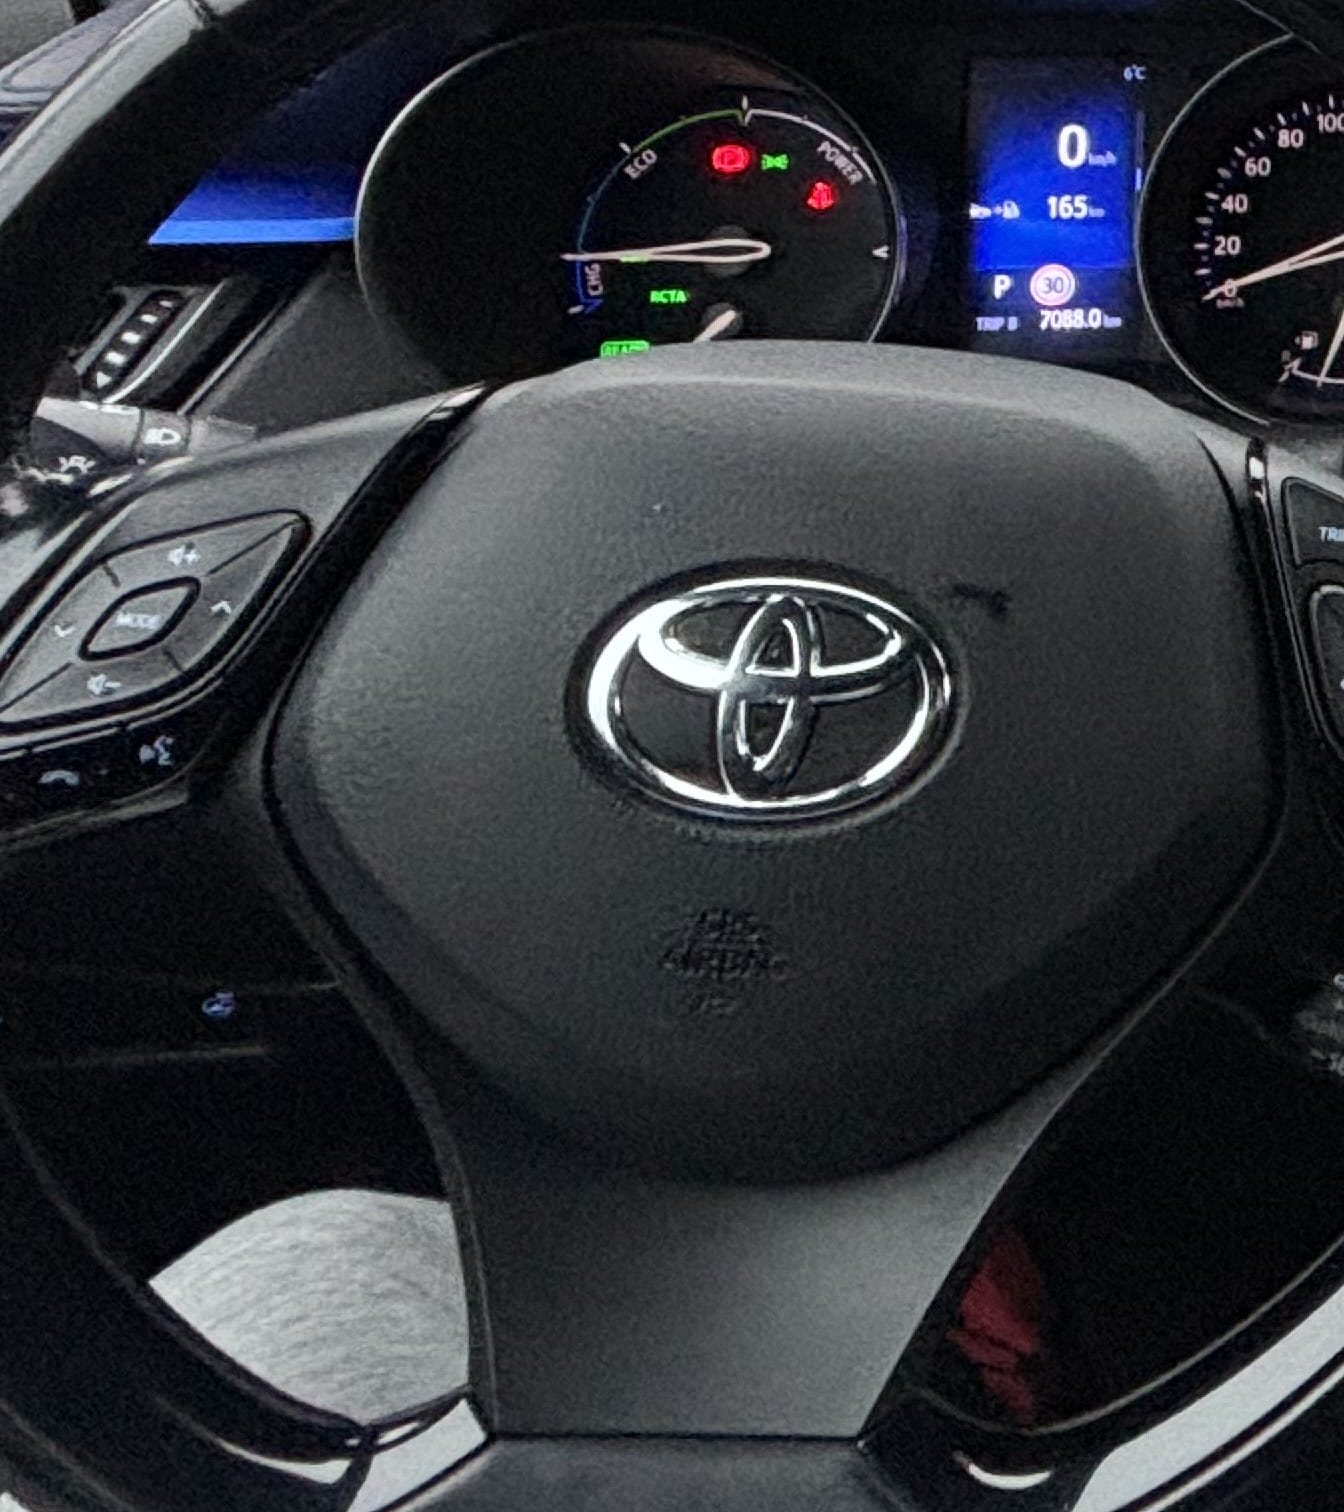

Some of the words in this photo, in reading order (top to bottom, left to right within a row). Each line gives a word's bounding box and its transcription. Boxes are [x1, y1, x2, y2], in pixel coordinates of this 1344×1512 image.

[1058, 124, 1087, 169] 0
[1277, 129, 1304, 149] 80
[624, 149, 658, 179] ECO
[816, 140, 864, 186] POWER
[1244, 157, 1272, 177] 60
[1047, 195, 1088, 219] 165
[1221, 194, 1248, 213] 40
[1214, 235, 1241, 256] 20
[585, 263, 604, 296] CHG
[994, 275, 1013, 299] P
[1042, 276, 1065, 295] 30
[650, 290, 688, 304] RCTA
[116, 614, 162, 630] MODE
